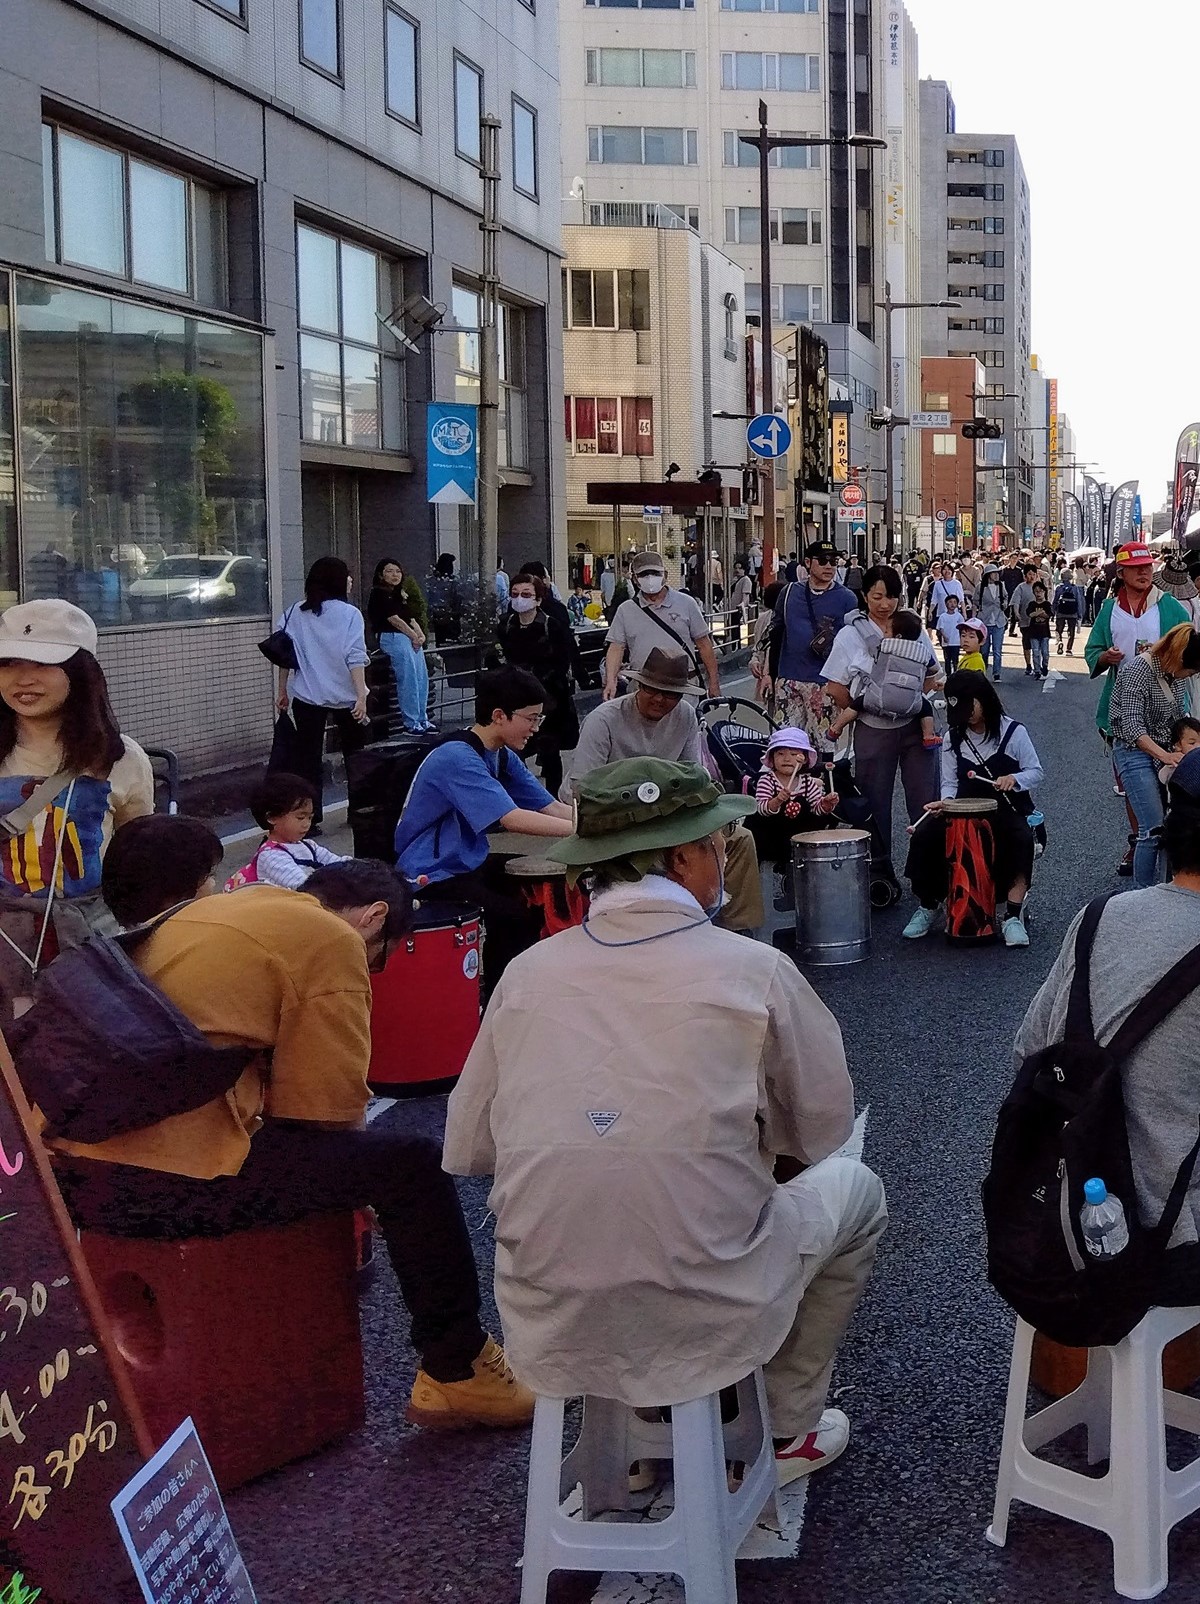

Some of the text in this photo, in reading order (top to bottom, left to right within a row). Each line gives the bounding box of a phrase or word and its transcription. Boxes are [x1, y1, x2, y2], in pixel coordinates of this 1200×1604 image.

[837, 438, 848, 467] ぬりや
[137, 1458, 199, 1532] ご参加の皆さんへ
